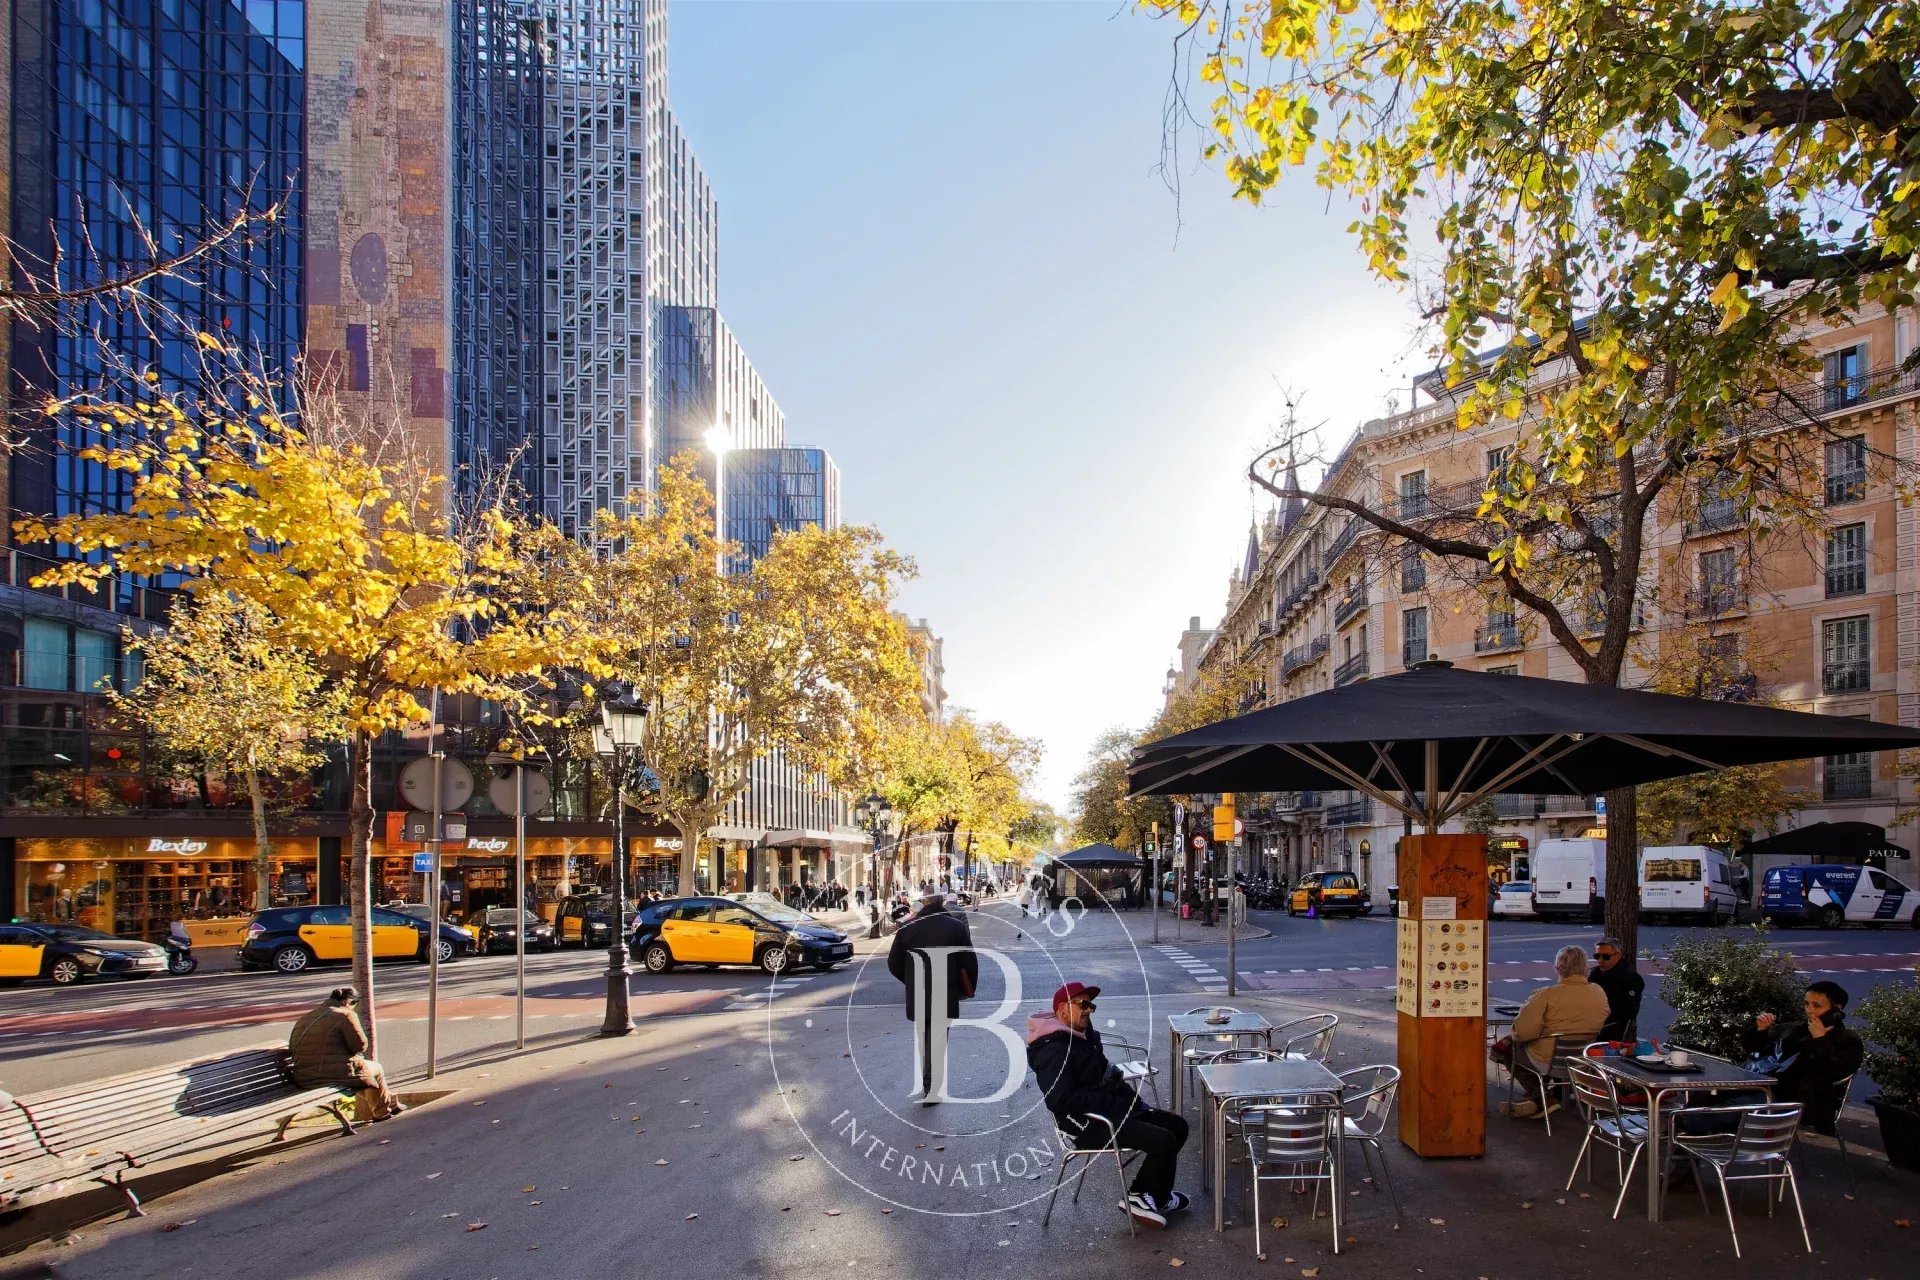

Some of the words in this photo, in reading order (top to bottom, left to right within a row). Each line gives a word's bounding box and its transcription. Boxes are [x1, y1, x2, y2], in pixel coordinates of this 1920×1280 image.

[146, 839, 207, 855] Bexley
[467, 838, 508, 852] Bexley
[1869, 849, 1901, 858] PAUL
